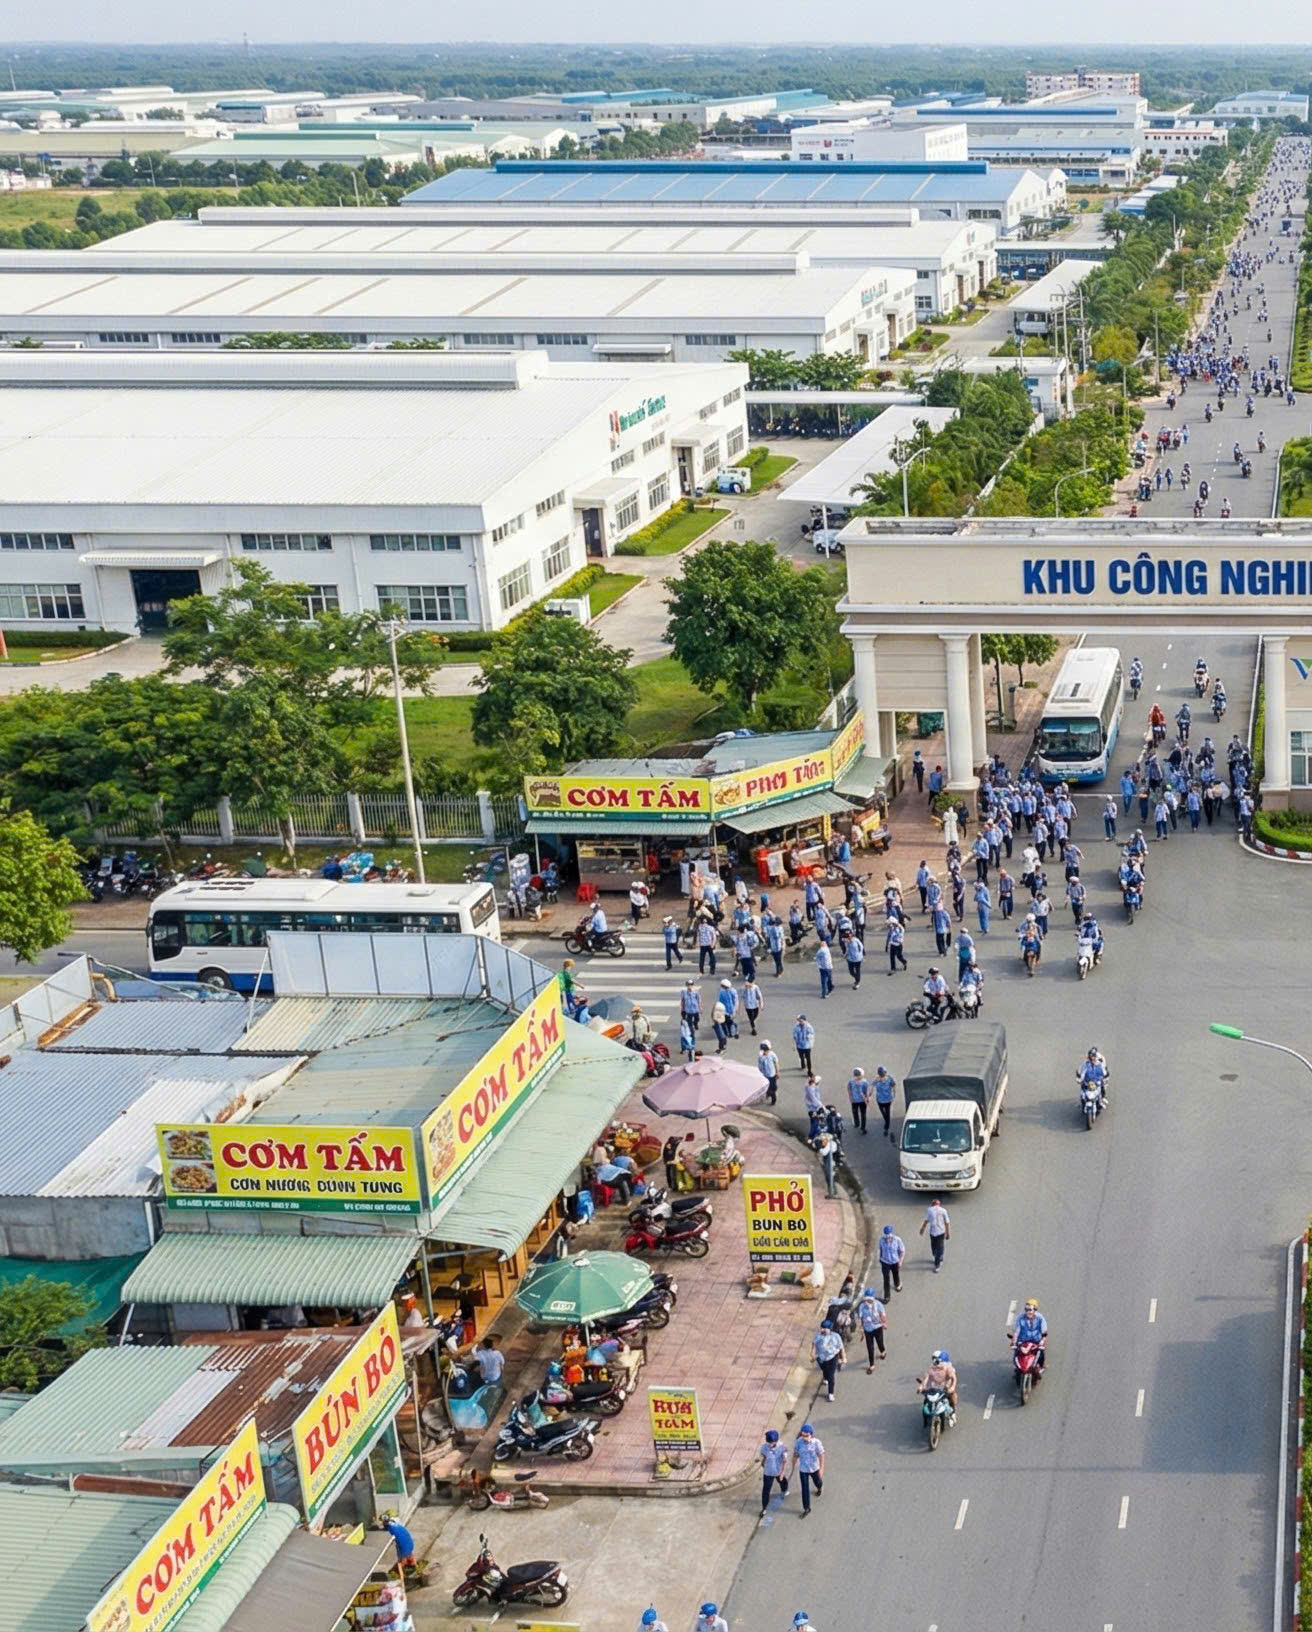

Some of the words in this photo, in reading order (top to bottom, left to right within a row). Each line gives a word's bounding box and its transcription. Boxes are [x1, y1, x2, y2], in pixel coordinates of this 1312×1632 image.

[1023, 560, 1095, 595] KHU
[1108, 552, 1207, 596] CÔNG
[567, 786, 629, 808] CƠM
[637, 781, 700, 808] TẤM
[458, 1064, 508, 1144] CƠM
[512, 1008, 559, 1083] TẤM
[222, 1139, 308, 1170] CƠM
[316, 1132, 405, 1171] TẤM
[750, 1181, 804, 1212] PHỞ
[305, 1377, 360, 1475] BÚN
[136, 1523, 195, 1615] CƠM
[200, 1452, 254, 1537] TẤM
